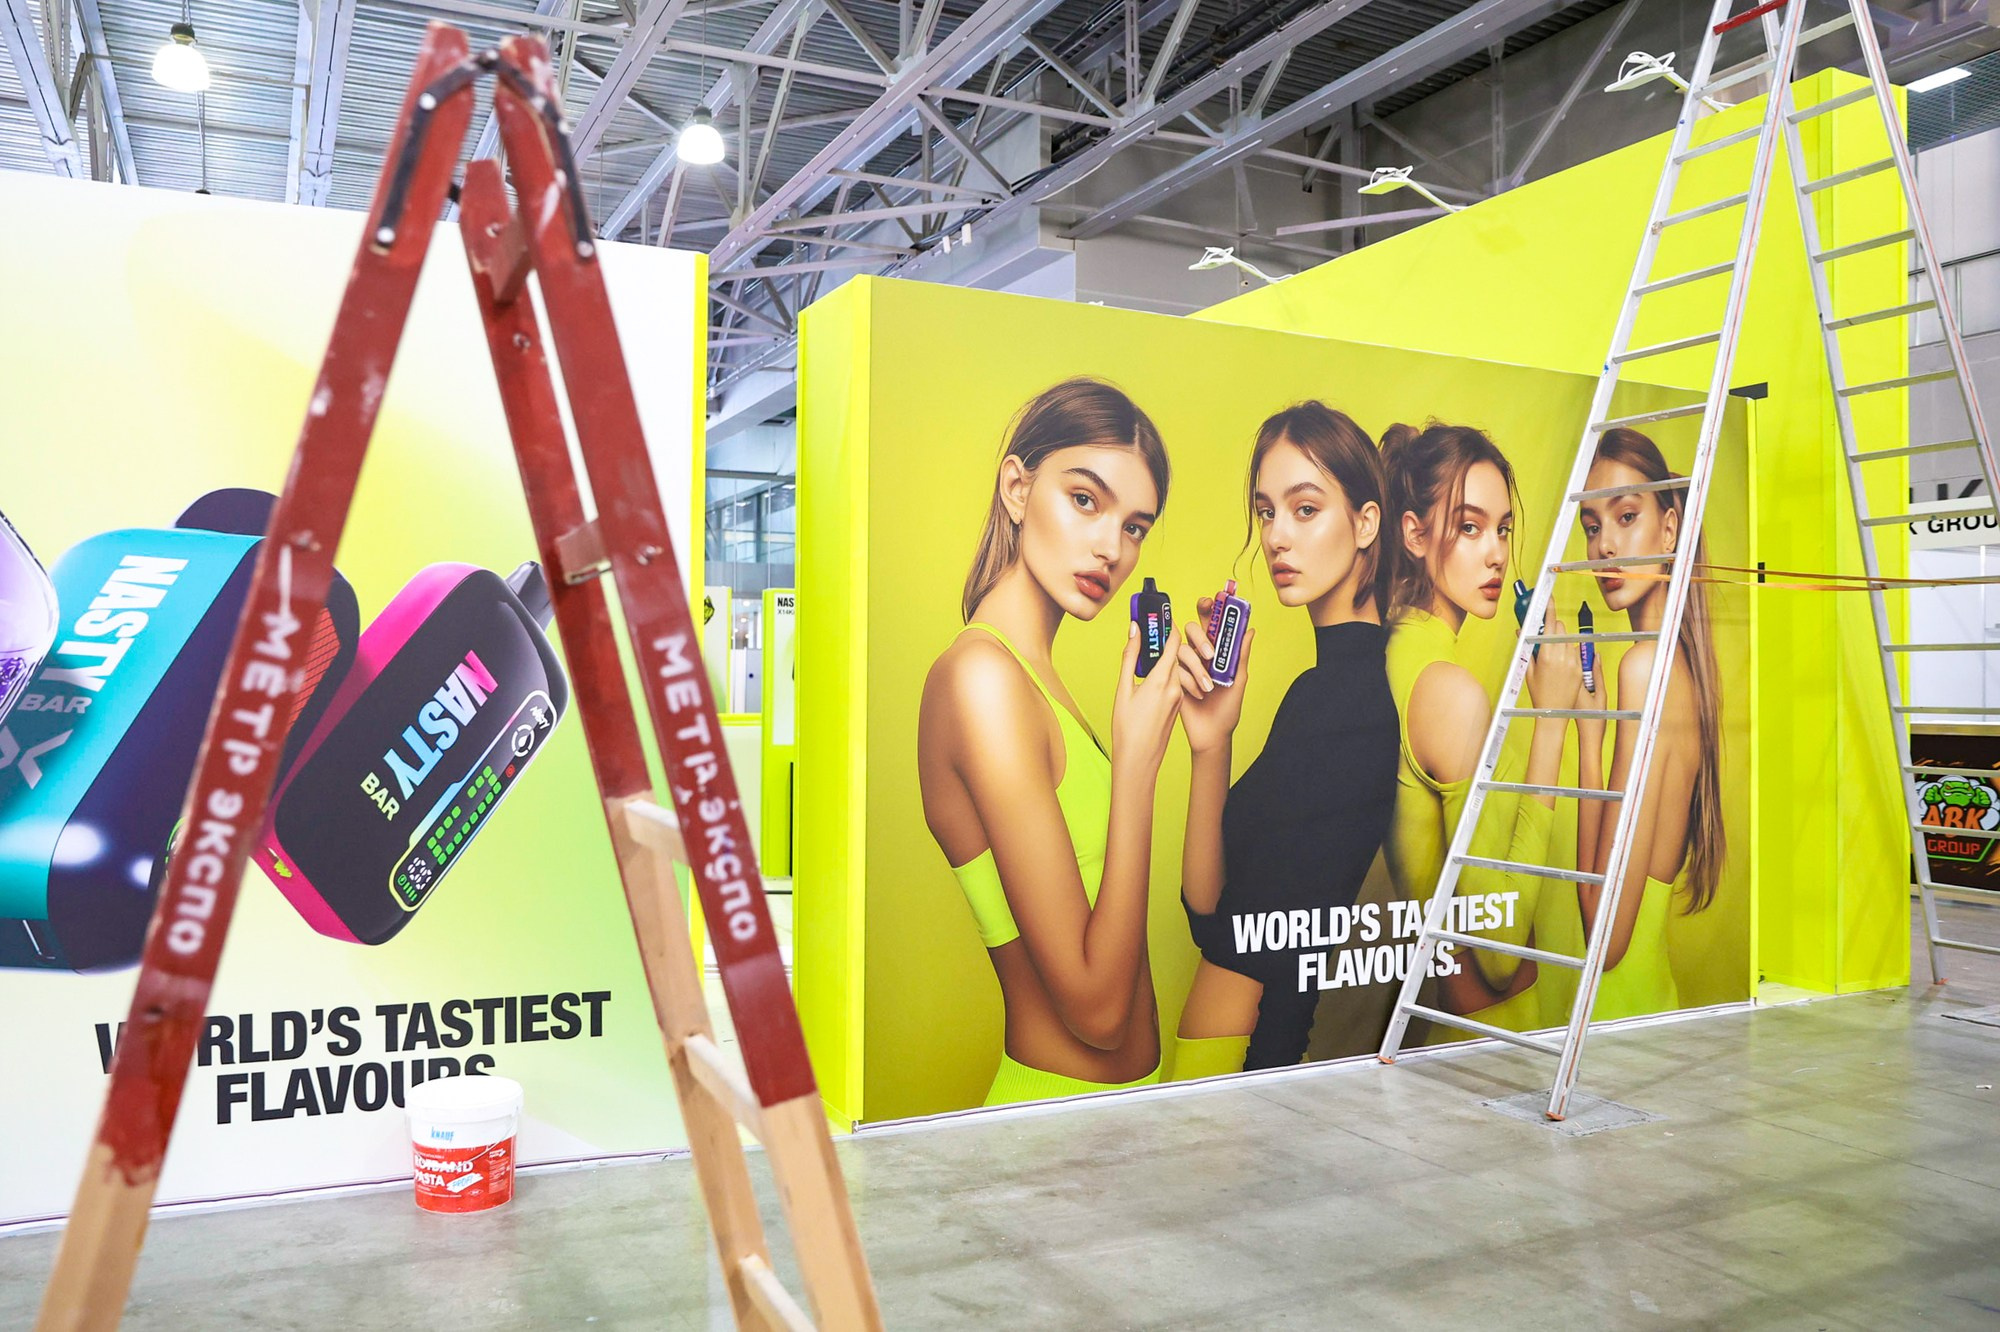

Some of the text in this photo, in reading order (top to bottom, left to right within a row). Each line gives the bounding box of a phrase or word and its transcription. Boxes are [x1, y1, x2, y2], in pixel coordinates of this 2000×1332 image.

[40, 555, 189, 692] NASTY
[1147, 613, 1159, 651] NASTY
[1208, 600, 1223, 637] NASTY
[17, 694, 92, 714] BAR
[383, 649, 498, 801] NASTY
[360, 772, 400, 821] BAR
[1927, 840, 1980, 855] GROUP
[95, 991, 611, 1074] RLD'S TASTIEST
